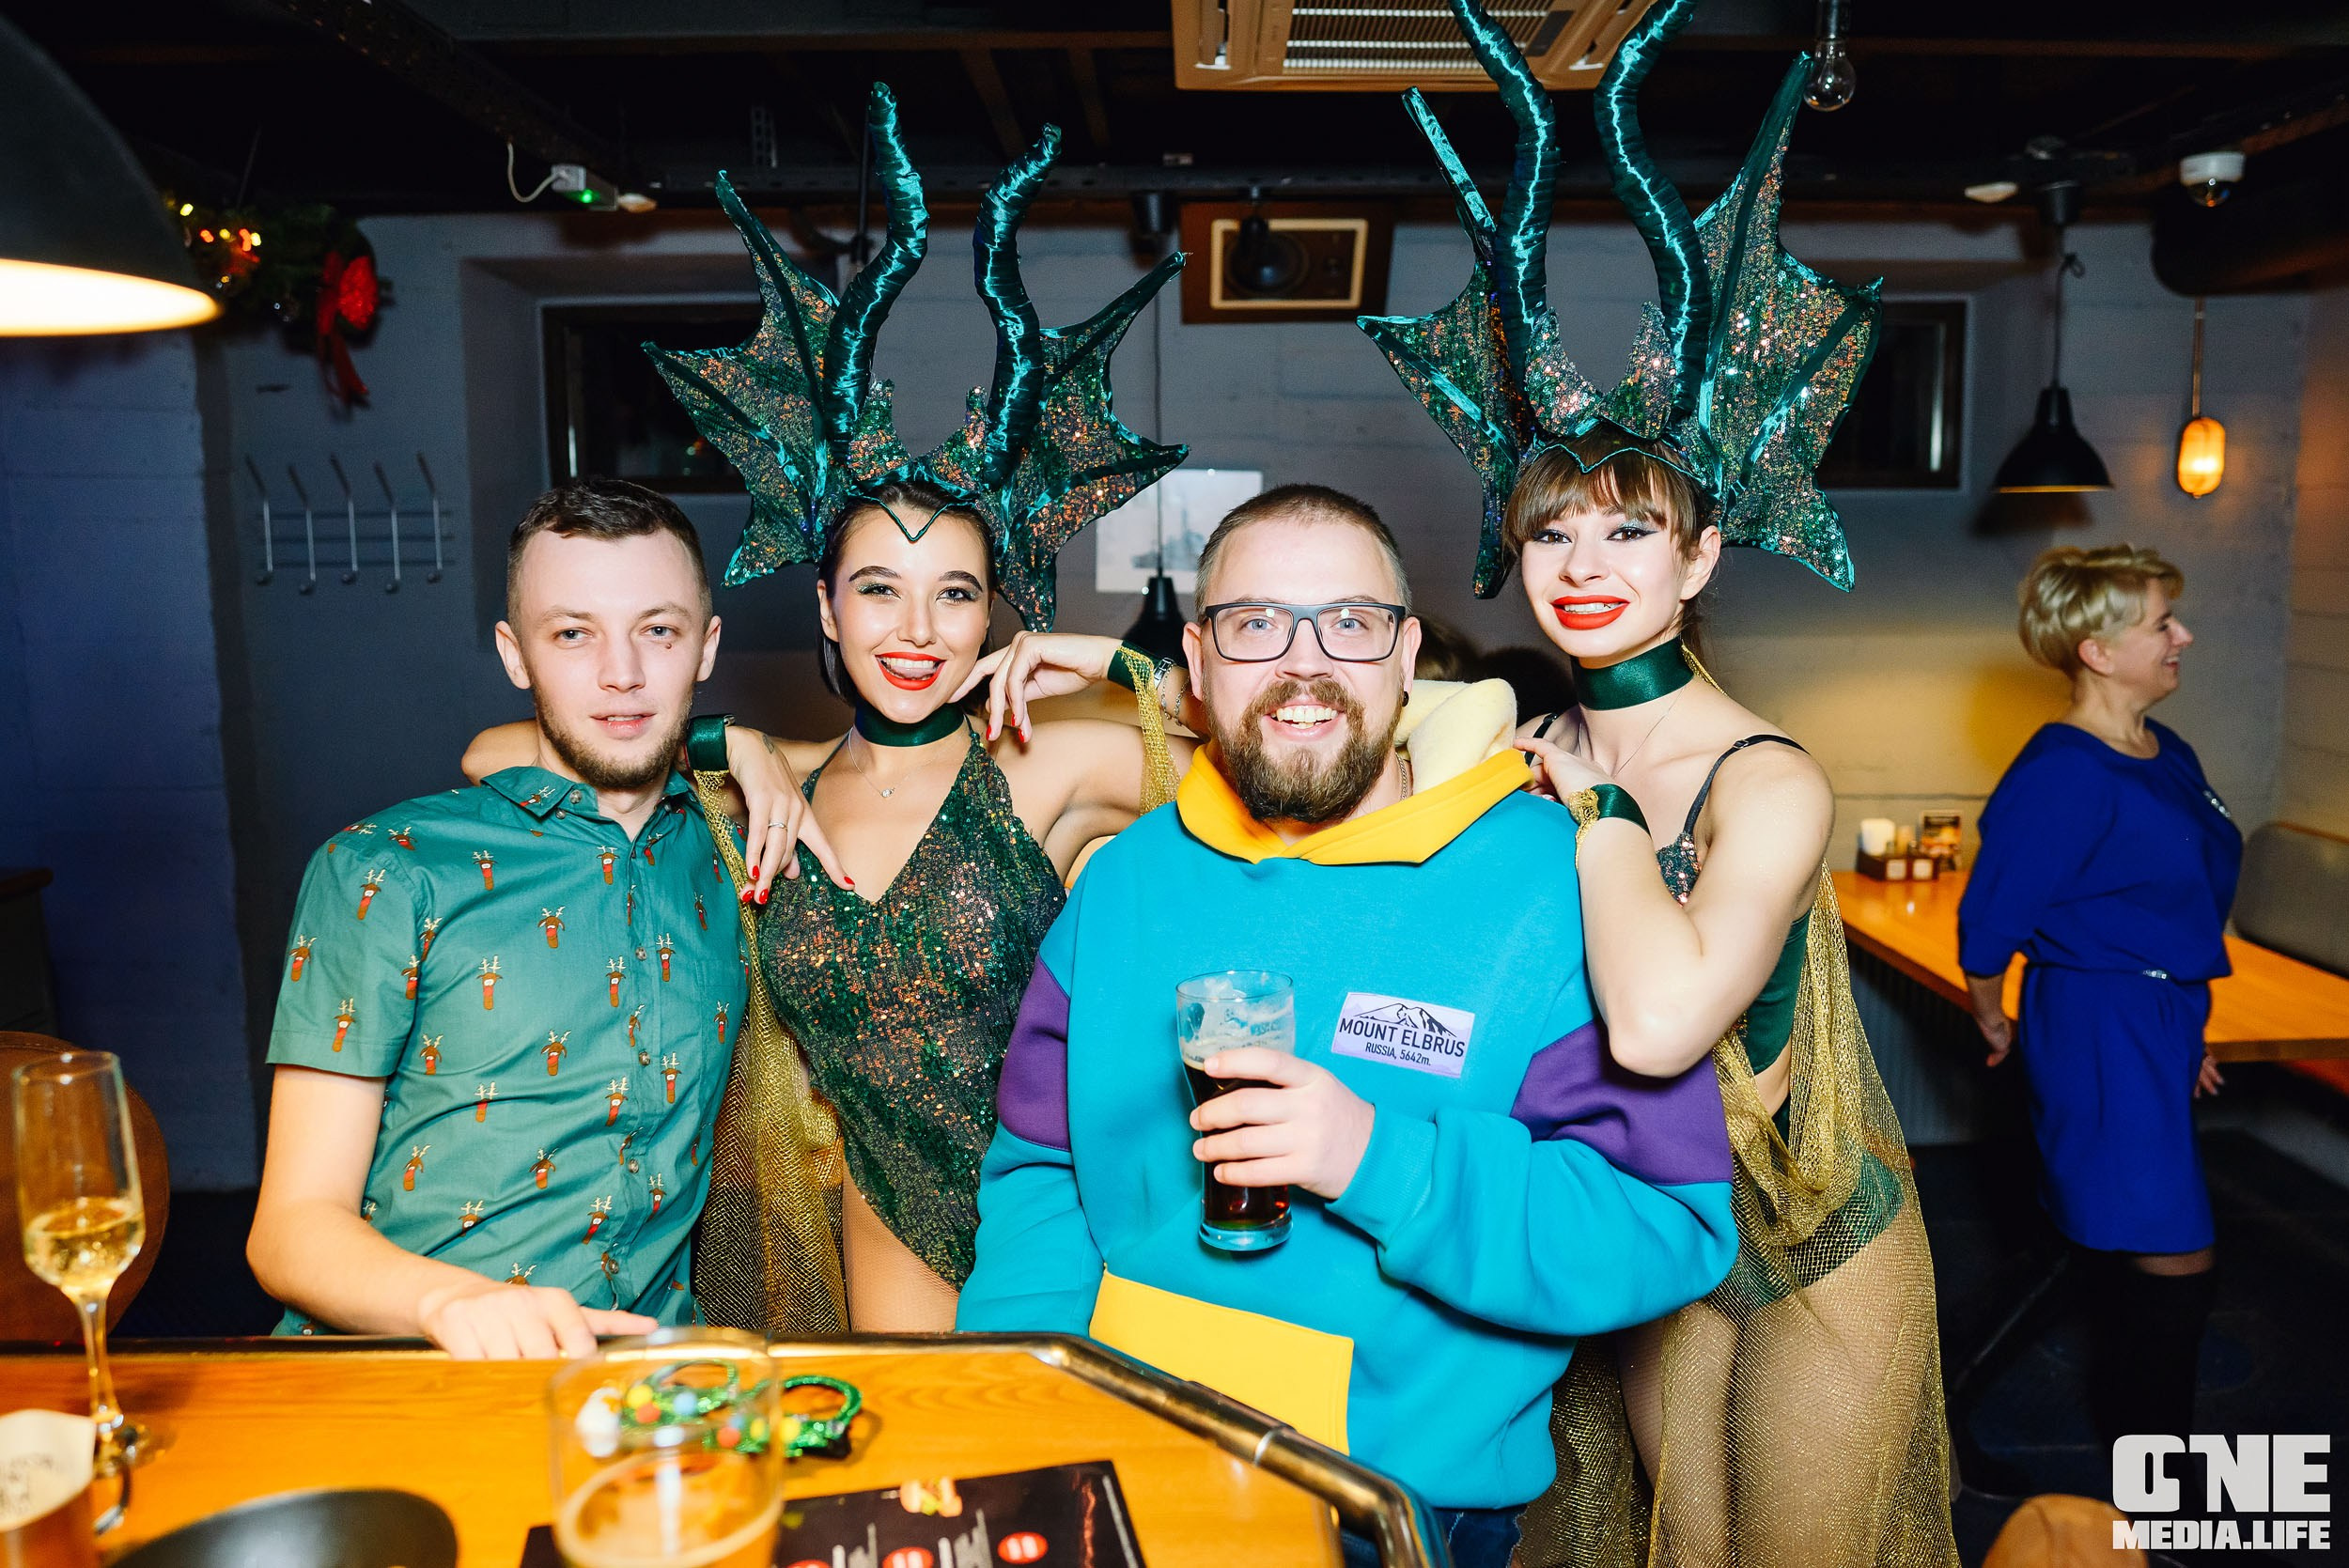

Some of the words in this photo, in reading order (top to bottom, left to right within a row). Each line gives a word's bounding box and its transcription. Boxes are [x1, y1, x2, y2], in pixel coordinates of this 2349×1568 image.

[1339, 1017, 1398, 1043] MOUNT
[1401, 1030, 1466, 1057] ELBRUS
[1365, 1042, 1397, 1060] RUSSIA,
[1399, 1050, 1431, 1066] 5642m.
